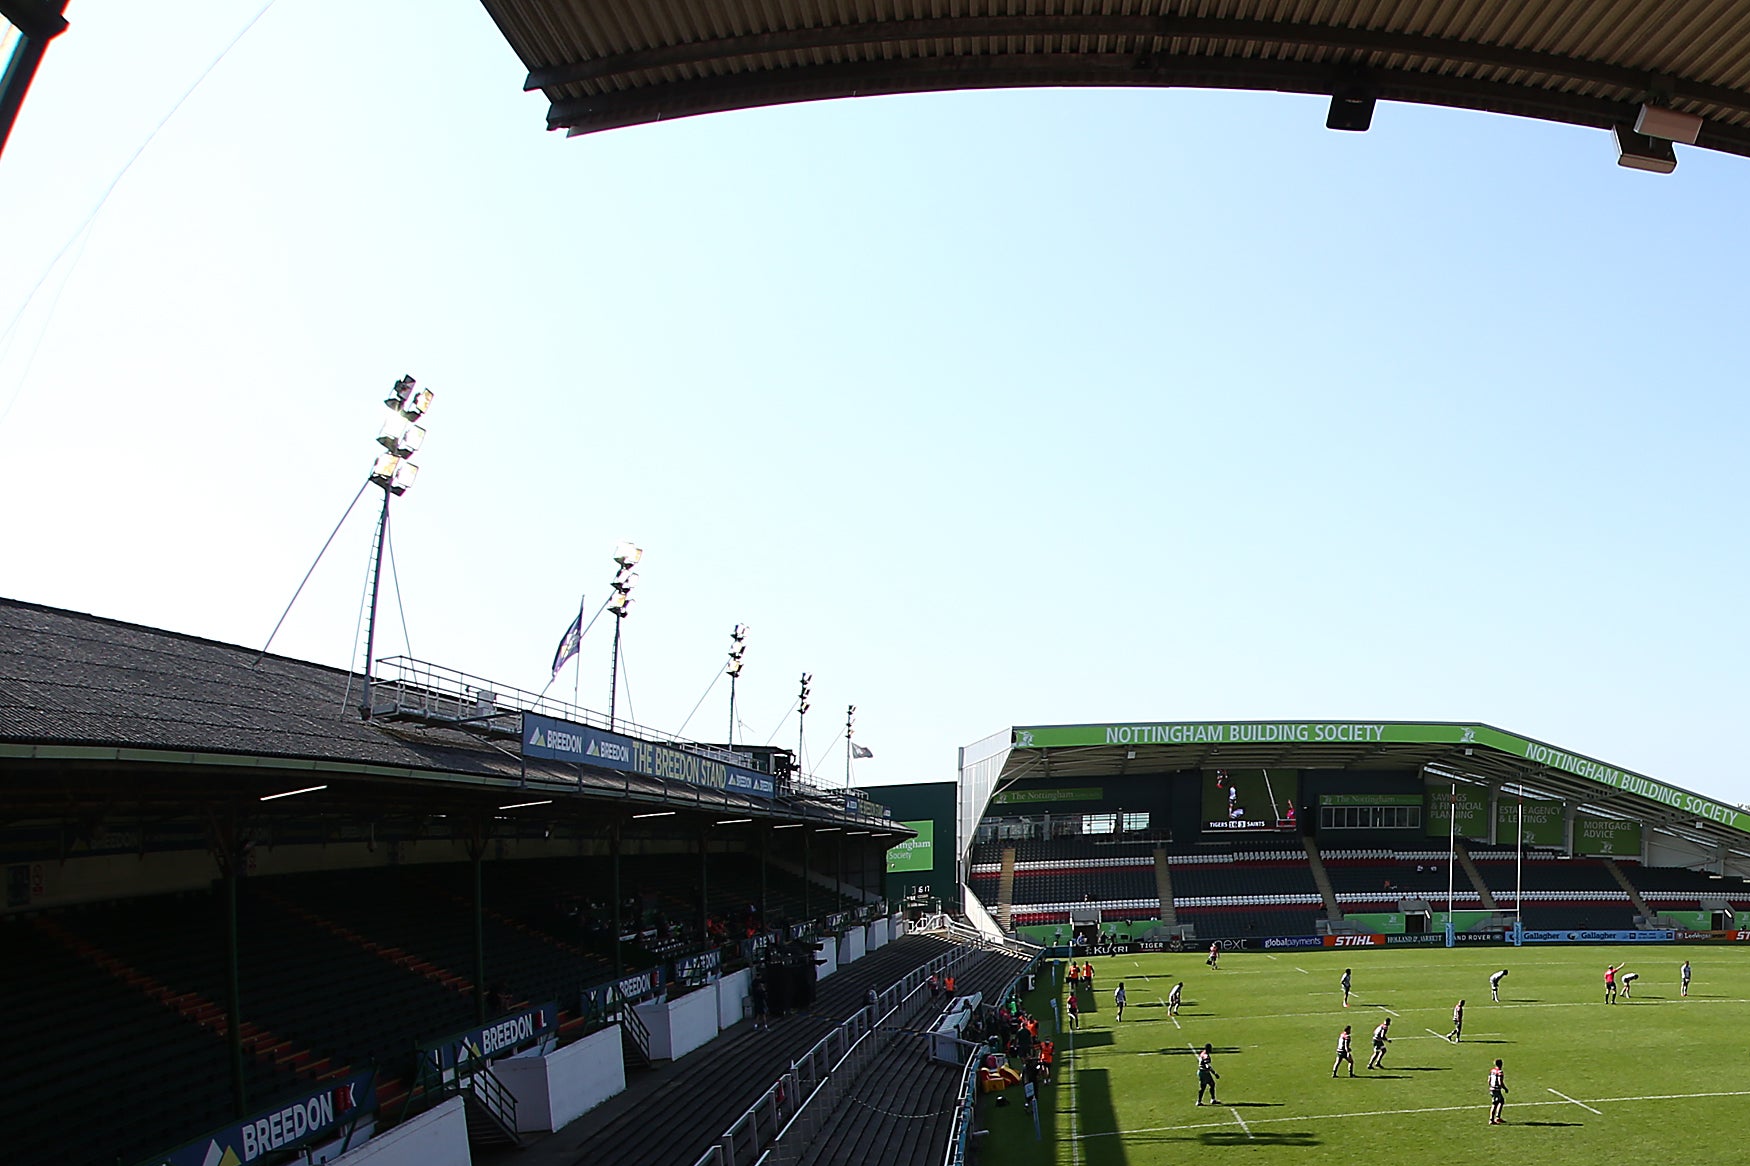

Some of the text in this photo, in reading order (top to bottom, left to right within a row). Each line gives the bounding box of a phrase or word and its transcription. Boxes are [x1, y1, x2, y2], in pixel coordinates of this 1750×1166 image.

[1106, 725, 1385, 744] NOTTINGHAM BUILDING SOCIETY
[546, 729, 582, 754] BREEDON
[600, 740, 630, 764] BREEDON
[632, 741, 726, 789] THE BREEDON STAND
[1525, 743, 1739, 826] NOTTINGHAM BUILDING SOCIETY
[1011, 792, 1026, 801] The
[1028, 790, 1074, 801] Nottingham
[1431, 793, 1468, 802] SAVIGS
[1500, 806, 1528, 814] ESTAE
[1508, 815, 1548, 824] LETINGS
[1584, 820, 1632, 830] MORTGAGE
[1584, 830, 1614, 838] ADVICE
[1334, 936, 1374, 946] STIHL
[1524, 932, 1560, 942] Gallagher
[1581, 932, 1616, 941] Gallagher
[1264, 937, 1321, 948] globalpayments
[482, 1012, 534, 1056] BREEDON
[240, 1090, 334, 1162] BREEDON
